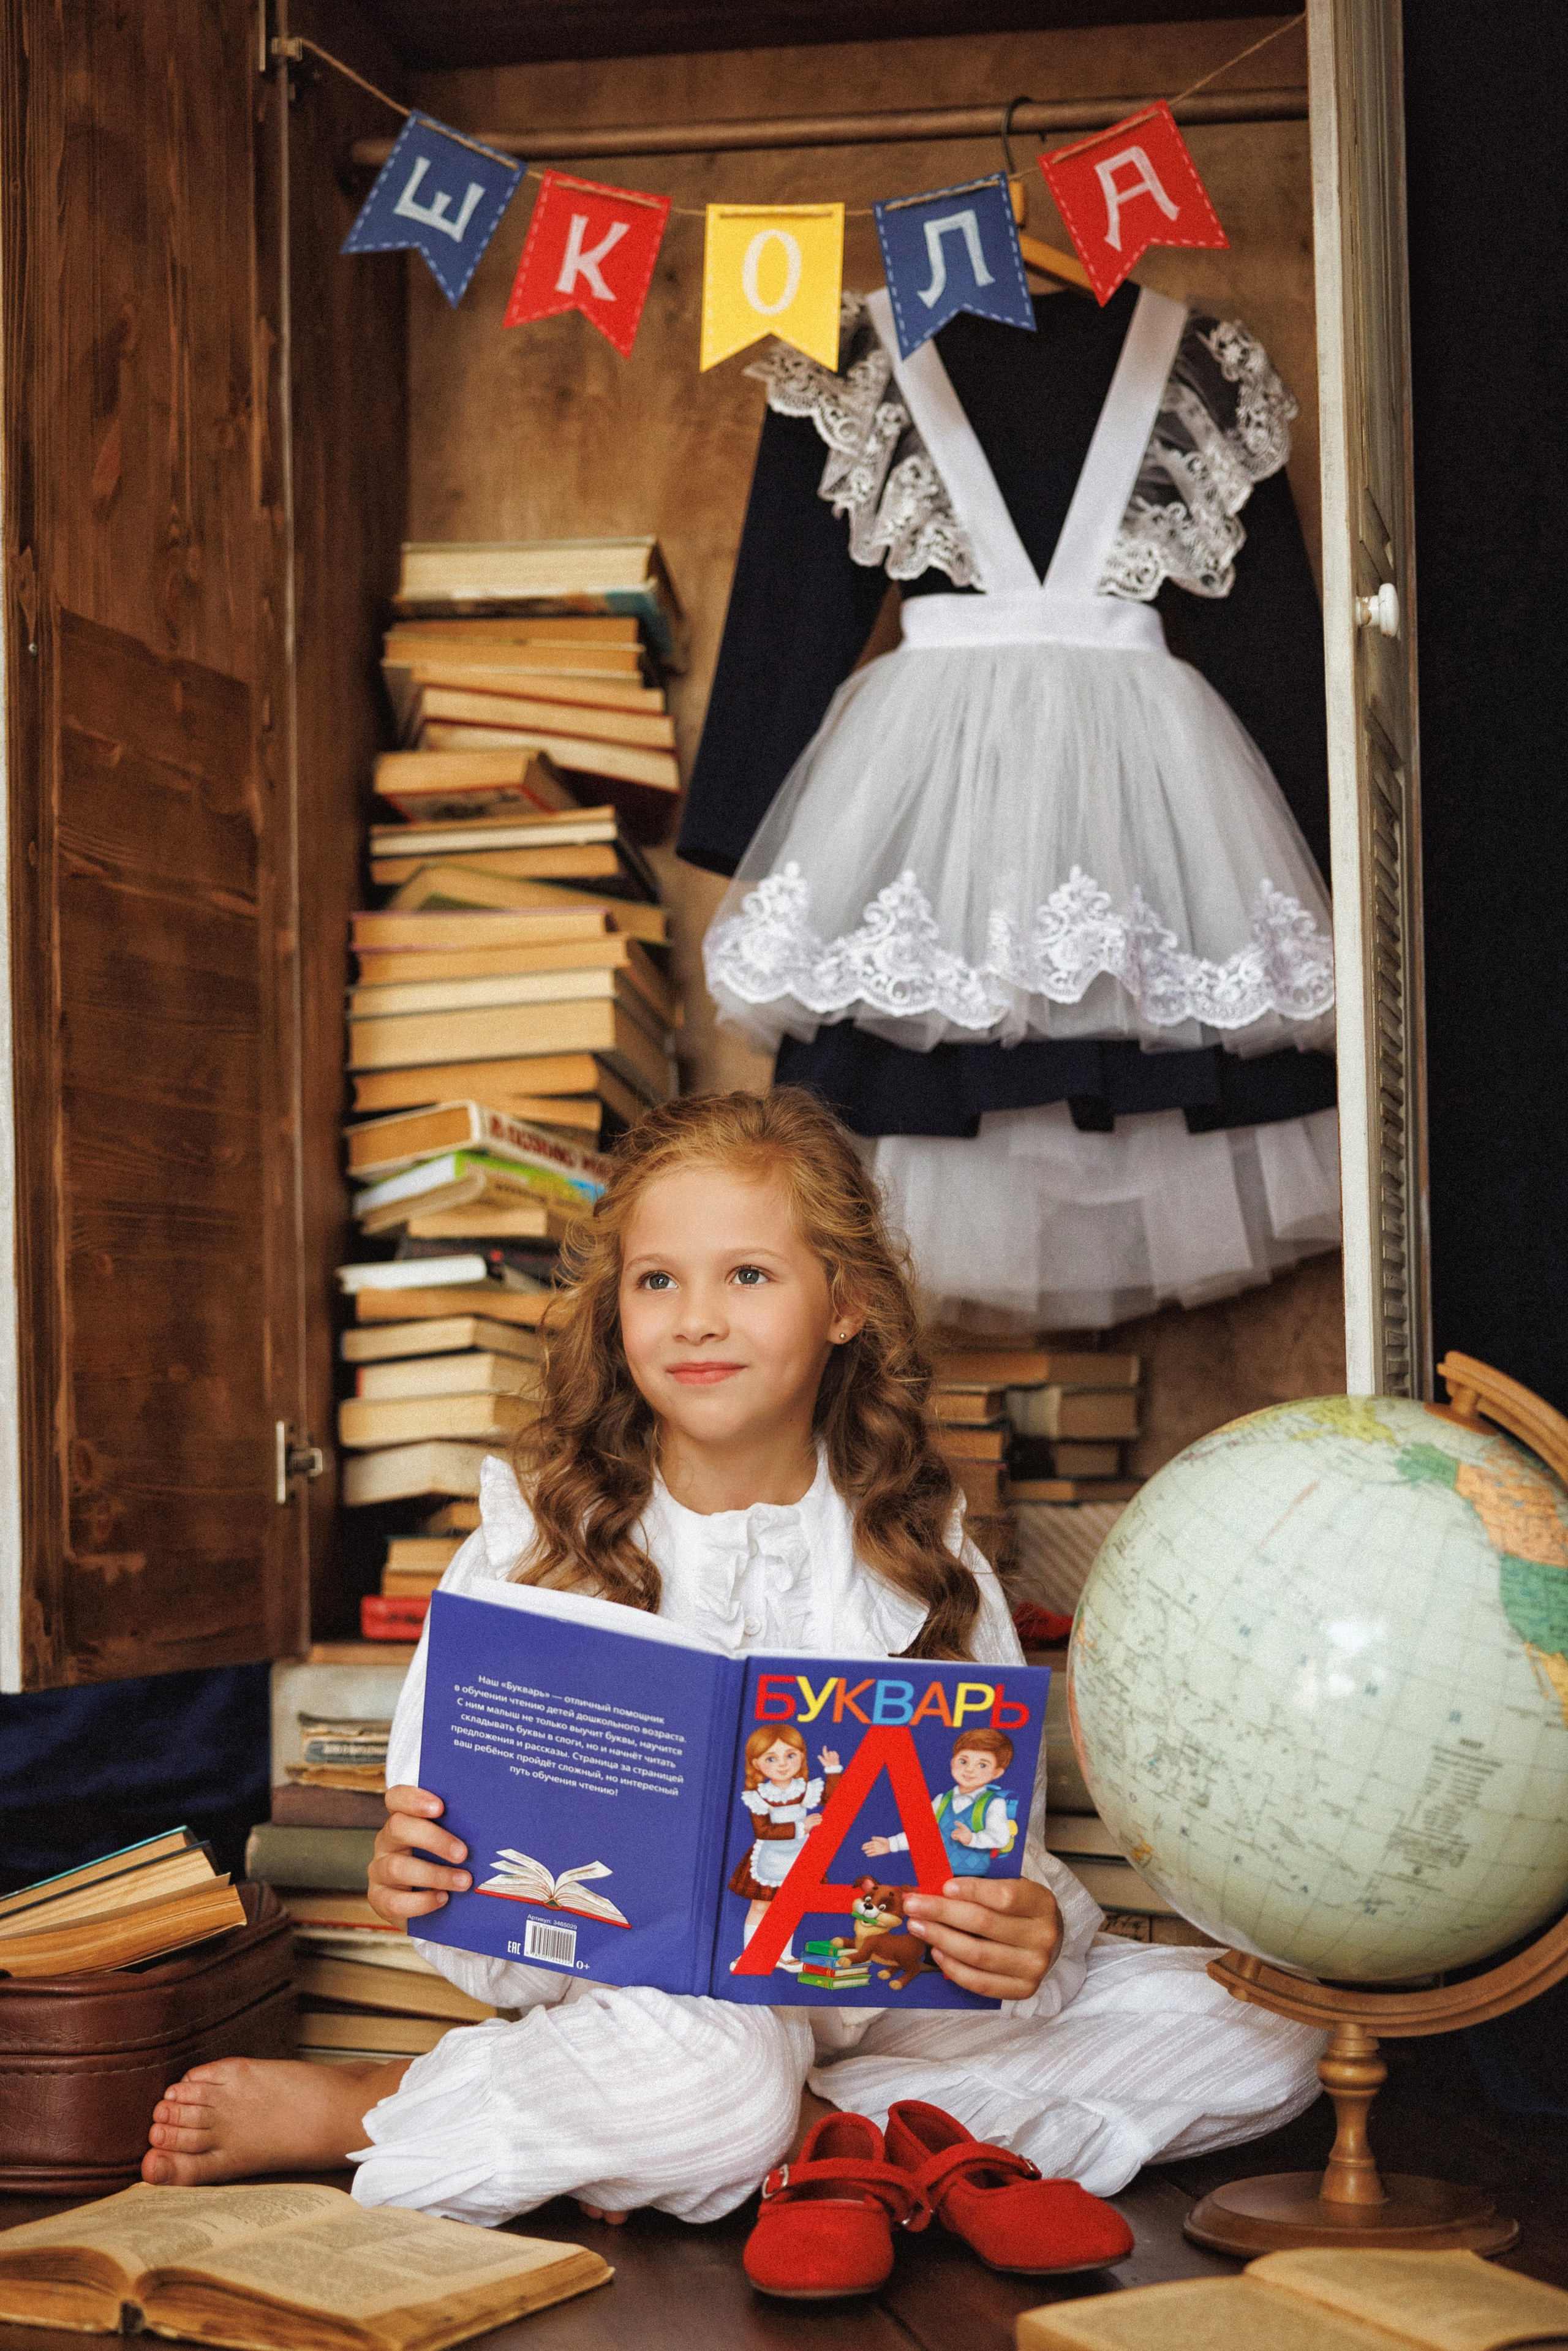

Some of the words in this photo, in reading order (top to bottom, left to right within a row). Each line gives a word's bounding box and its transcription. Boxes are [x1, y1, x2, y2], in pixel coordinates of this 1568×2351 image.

[461, 1686, 507, 1702] обучении
[509, 1697, 545, 1711] чтению
[546, 1706, 575, 1718] детей
[575, 1713, 640, 1732] дошкольного
[641, 1727, 686, 1742] возраста.
[478, 1675, 499, 1686] Наш
[501, 1681, 549, 1697] «Букварь»
[564, 1696, 611, 1711] отличный
[612, 1707, 664, 1724] помощник
[754, 1674, 1030, 1729] БУКВАРЬ
[451, 1724, 514, 1745] предложения
[524, 1742, 569, 1757] рассказы.
[572, 1751, 618, 1769] Страница
[632, 1767, 684, 1783] страницей
[461, 1713, 514, 1731] складывать
[516, 1724, 545, 1738] буквы
[555, 1735, 584, 1748] слоги,
[609, 1748, 642, 1760] начнёт
[644, 1756, 676, 1768] читать
[465, 1700, 484, 1710] ним
[486, 1705, 519, 1719] малыш
[535, 1717, 567, 1729] только
[569, 1725, 603, 1737] выучит
[605, 1731, 637, 1746] буквы,
[639, 1741, 682, 1755] научится
[453, 1738, 472, 1749] ваш
[474, 1744, 514, 1759] ребёнок
[516, 1754, 556, 1768] пройдёт
[558, 1764, 603, 1780] сложный,
[620, 1778, 678, 1795] интересный
[510, 1765, 530, 1776] путь
[532, 1770, 576, 1786] обучения
[578, 1782, 617, 1796] чтению!
[731, 1725, 956, 1979] А
[527, 1914, 551, 1924] Артикул:
[553, 1920, 578, 1930] 3465029
[576, 1960, 590, 1969] 0+
